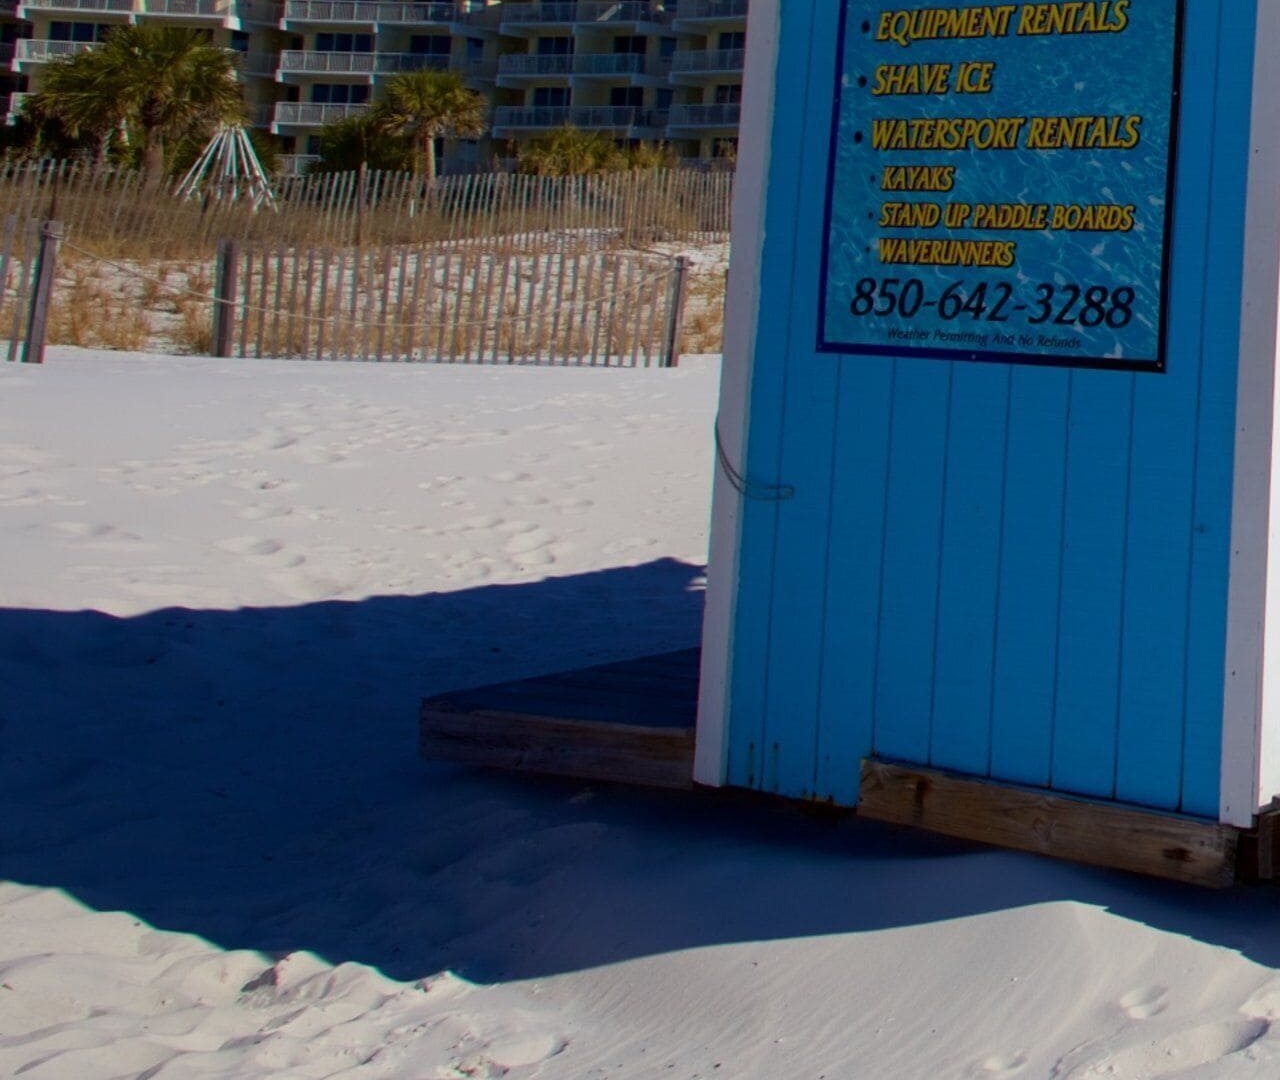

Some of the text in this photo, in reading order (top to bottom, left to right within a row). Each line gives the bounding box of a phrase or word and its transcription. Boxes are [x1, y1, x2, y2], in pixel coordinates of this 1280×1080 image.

[875, 0, 1130, 46] EQUIPMENT RENTALS
[871, 61, 995, 95] SHAVE ICE
[871, 116, 1142, 151] WATERSPORT RENTALS
[880, 165, 955, 192] KAYAKS
[879, 202, 1135, 232] STAND UP PADDLE BOARDS
[878, 238, 1016, 267] WAVERUNNERS
[850, 277, 1136, 329] 850-642-3288
[887, 327, 930, 341] Weather
[992, 331, 1015, 346] And
[1018, 333, 1035, 347] No
[1037, 334, 1082, 350] Refunds
